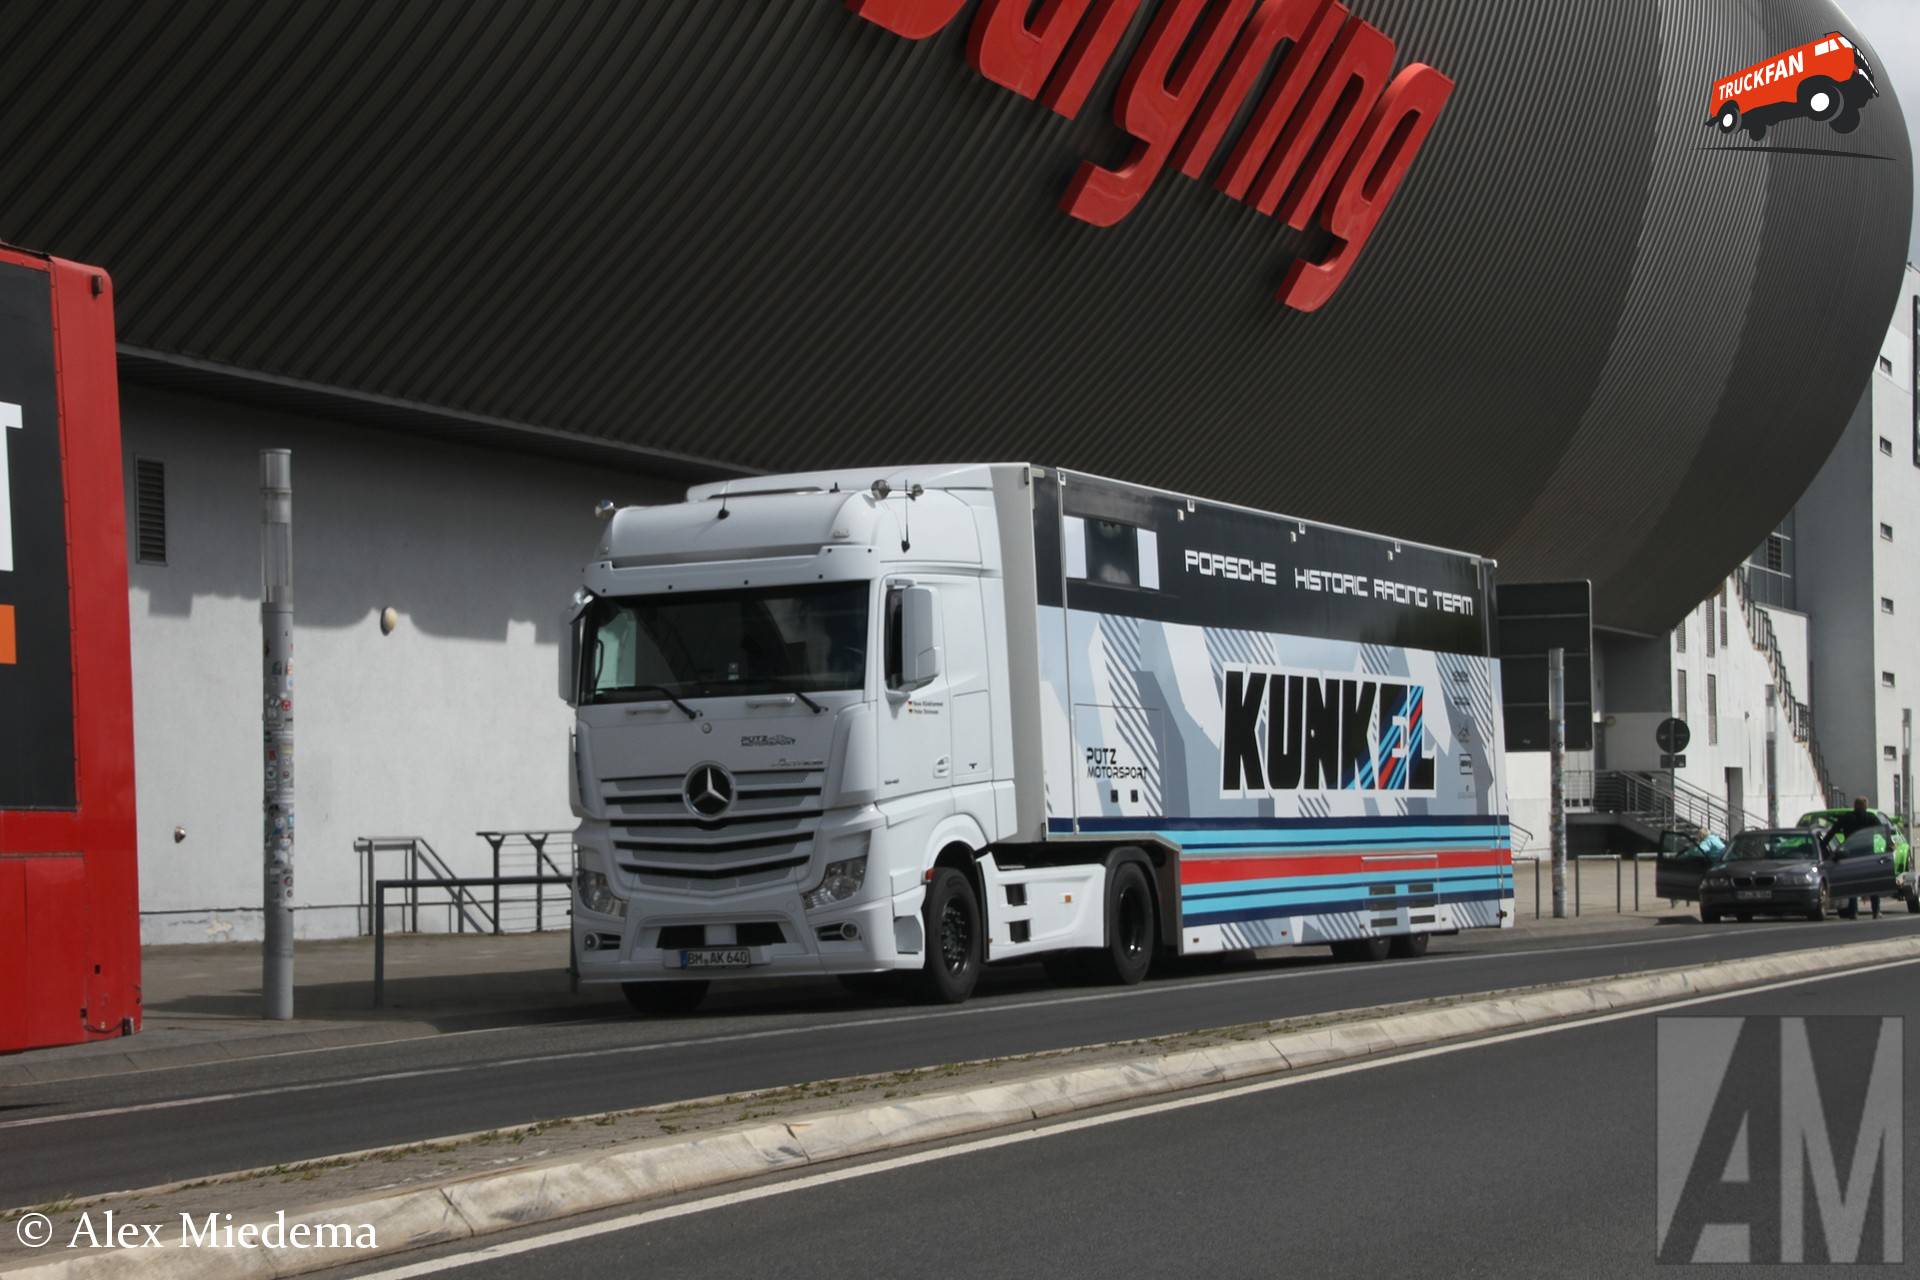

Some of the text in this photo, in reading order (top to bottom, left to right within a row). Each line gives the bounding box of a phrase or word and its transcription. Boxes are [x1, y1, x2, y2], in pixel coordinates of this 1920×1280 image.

[1184, 549, 1473, 616] PORSCHE HISTORIC RACING TEAM
[1222, 668, 1436, 792] KUNKEL
[1087, 766, 1148, 780] MOTORSPORT
